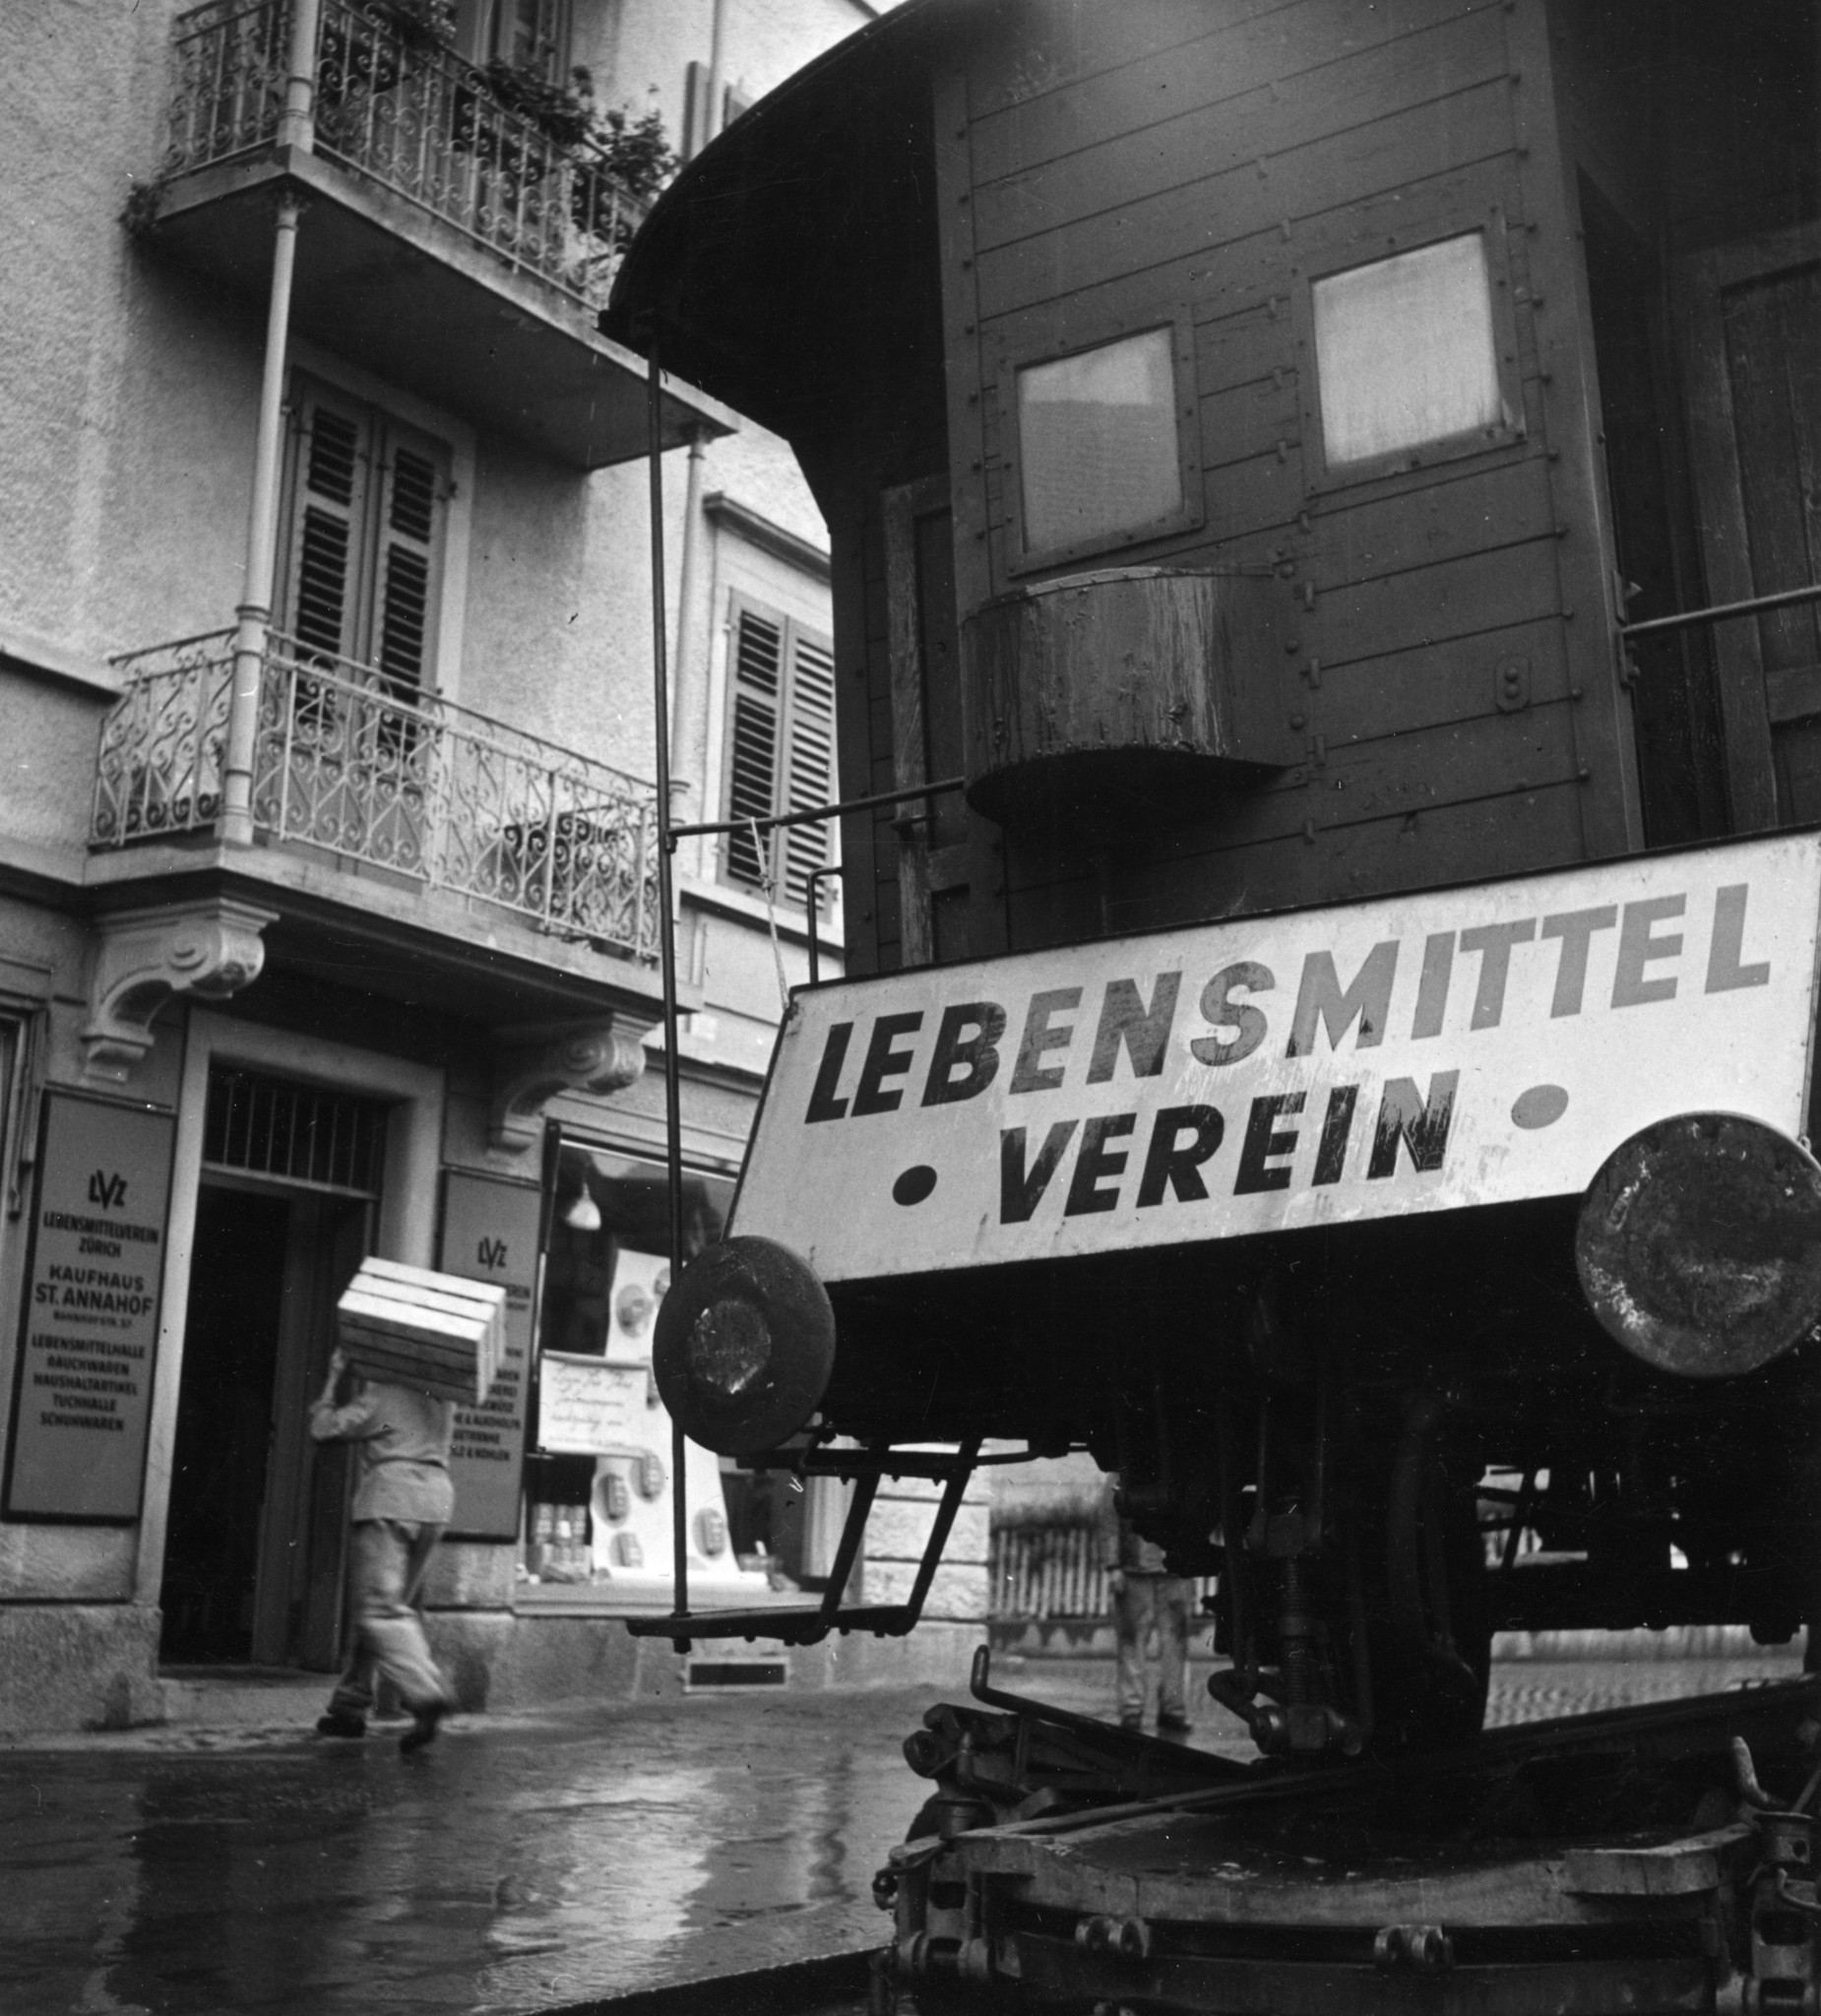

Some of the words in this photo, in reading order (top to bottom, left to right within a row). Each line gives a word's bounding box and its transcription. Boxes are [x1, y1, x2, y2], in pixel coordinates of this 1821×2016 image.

[804, 883, 1771, 1124] LEBENSMITTEL
[999, 1069, 1460, 1225] VEREIN
[90, 1168, 128, 1210] LVZ
[43, 1211, 159, 1244] LEBENSMITTELVEREIN
[79, 1235, 122, 1258] ZÜRICH
[477, 1236, 507, 1271] LVZ
[49, 1264, 145, 1292] KAUFHAUS
[35, 1283, 59, 1305] ST.
[62, 1287, 154, 1317] ANNAHOF
[31, 1334, 145, 1359] LEBENSMITTELHALLE
[47, 1354, 130, 1376] RAUCHWAREN
[33, 1372, 137, 1396] HAUSHALTARTIKEL
[53, 1393, 116, 1413] TUCHHALLE
[40, 1411, 124, 1431] SCHUHWAREN
